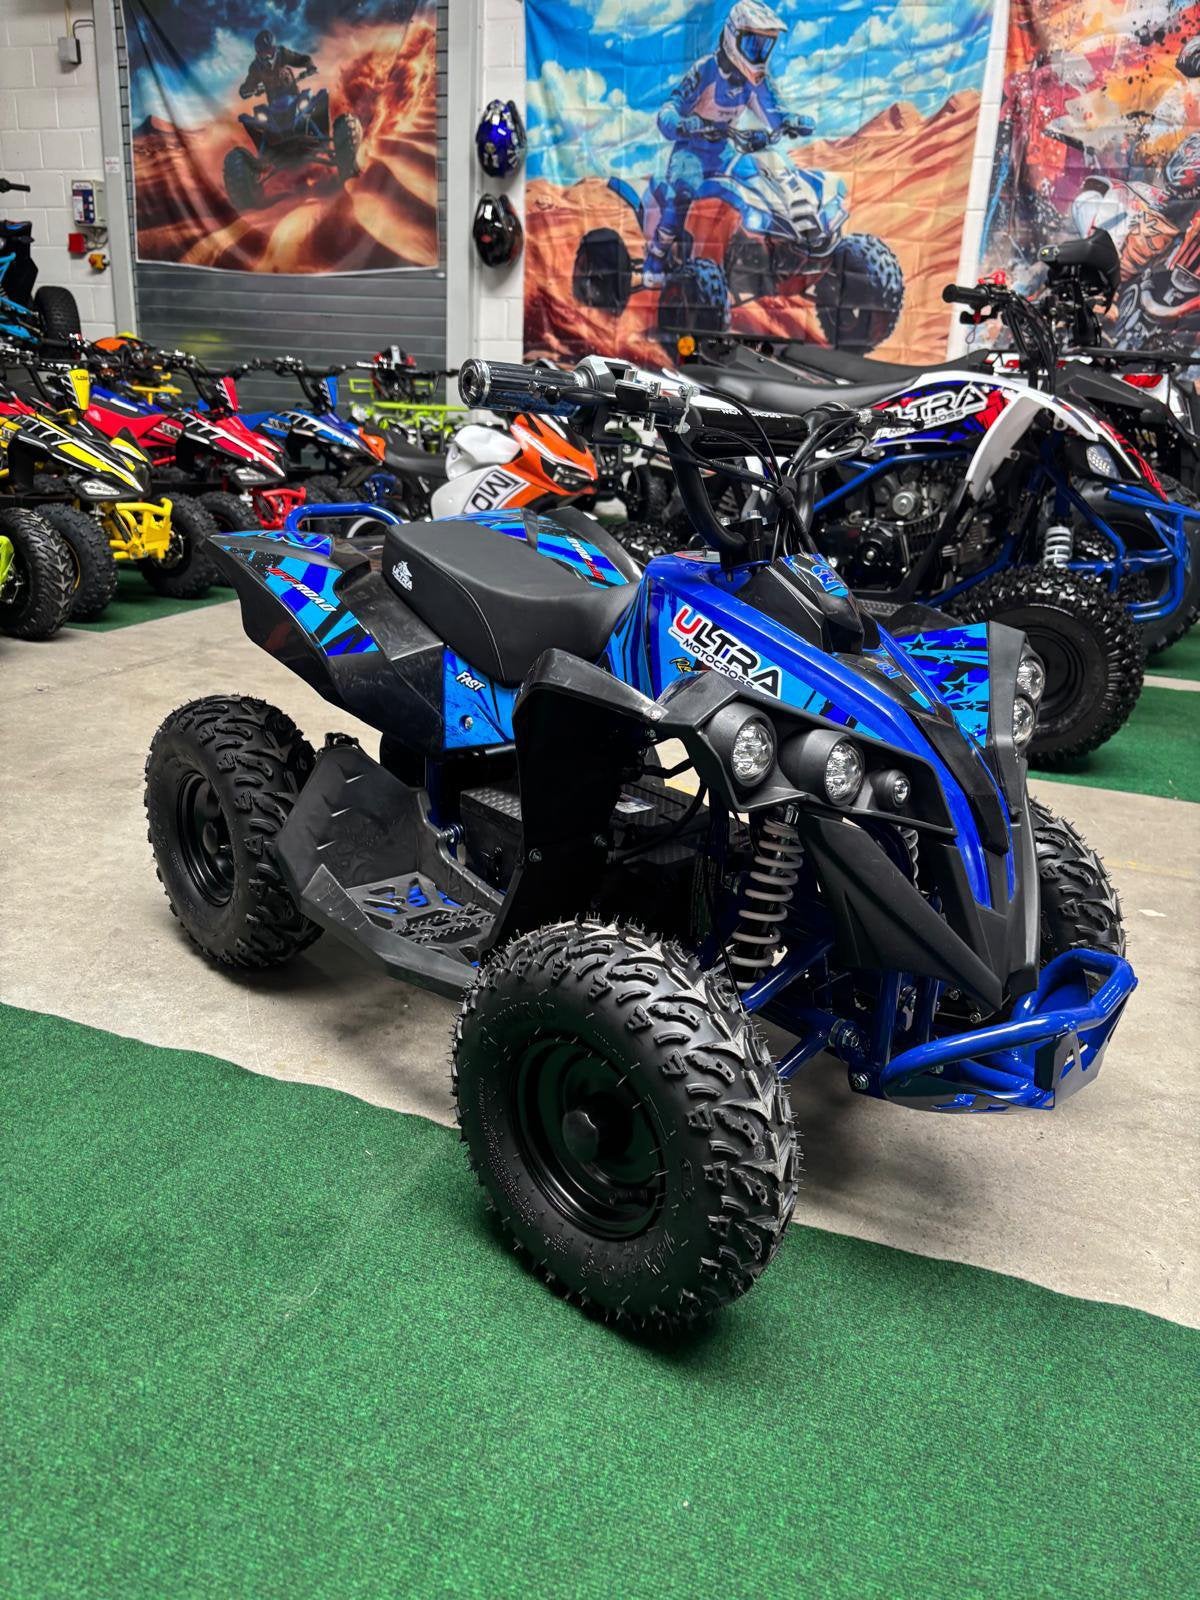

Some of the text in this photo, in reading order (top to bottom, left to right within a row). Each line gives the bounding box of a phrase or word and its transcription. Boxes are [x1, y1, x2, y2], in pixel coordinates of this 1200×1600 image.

[675, 607, 780, 698] ULTRA
[683, 637, 756, 689] MOTOCROSS
[456, 671, 486, 691] FAST
